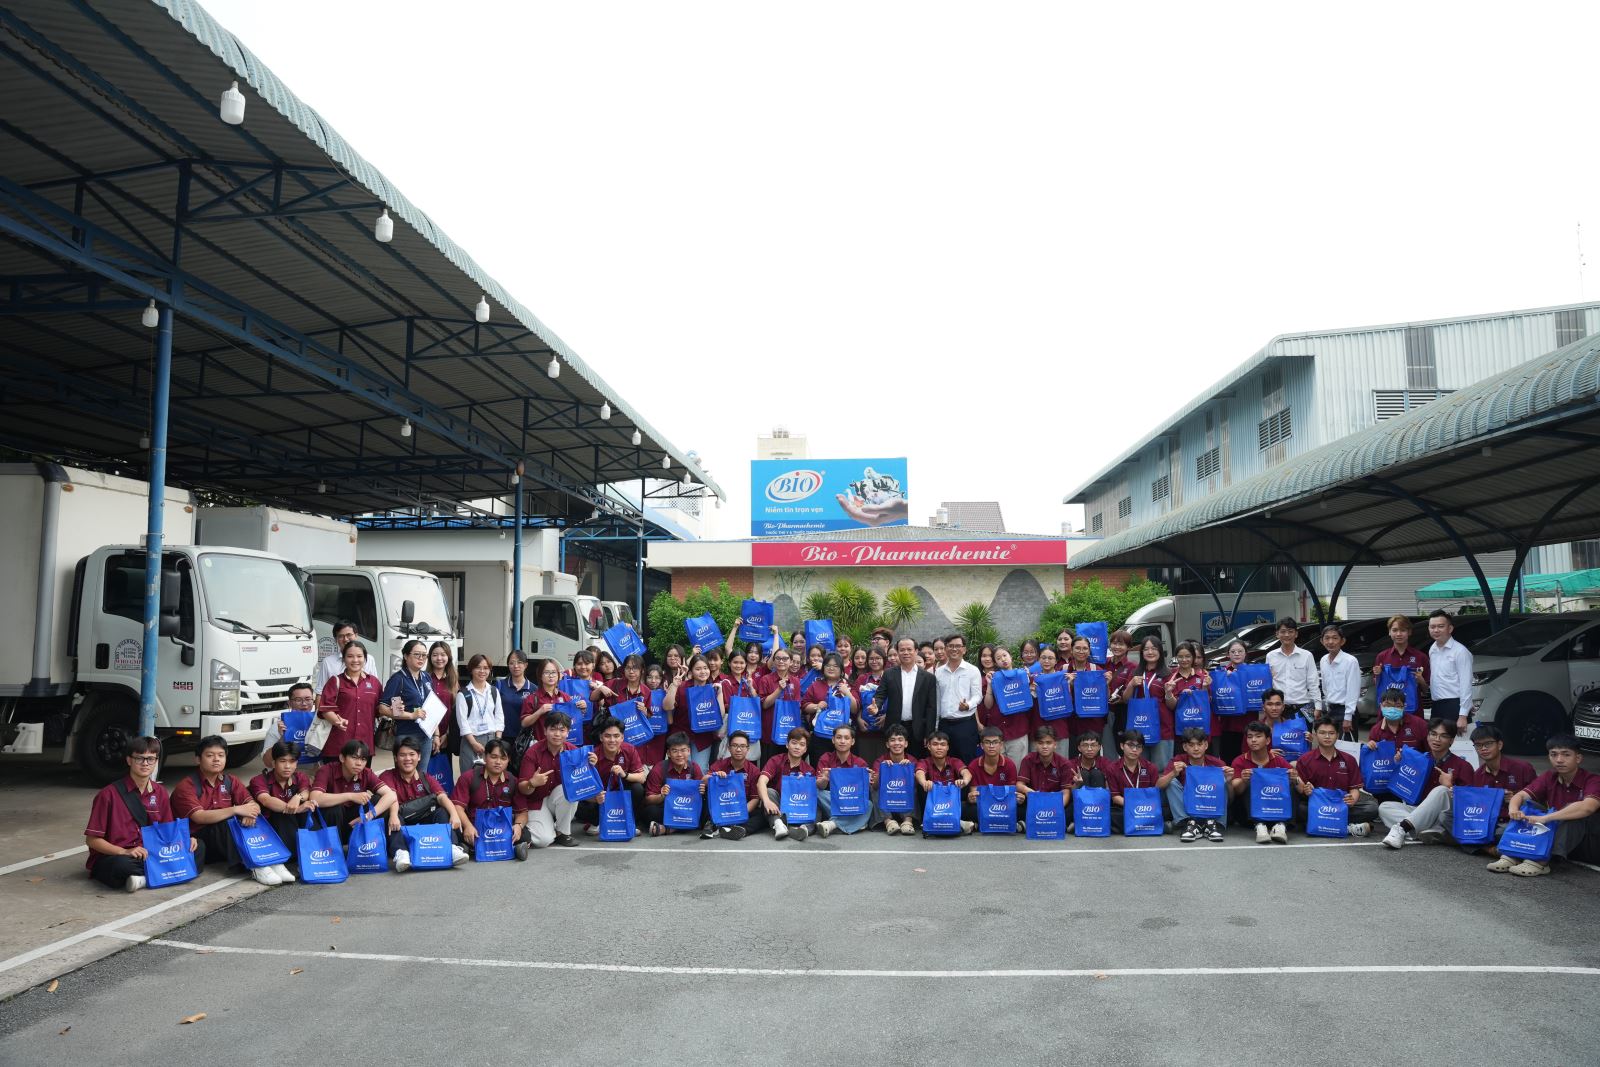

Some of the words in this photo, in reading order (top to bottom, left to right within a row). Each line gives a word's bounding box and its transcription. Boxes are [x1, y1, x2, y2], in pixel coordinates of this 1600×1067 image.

[795, 506, 810, 514] trọn
[800, 545, 839, 561] Bio
[269, 667, 292, 675] ISUZU
